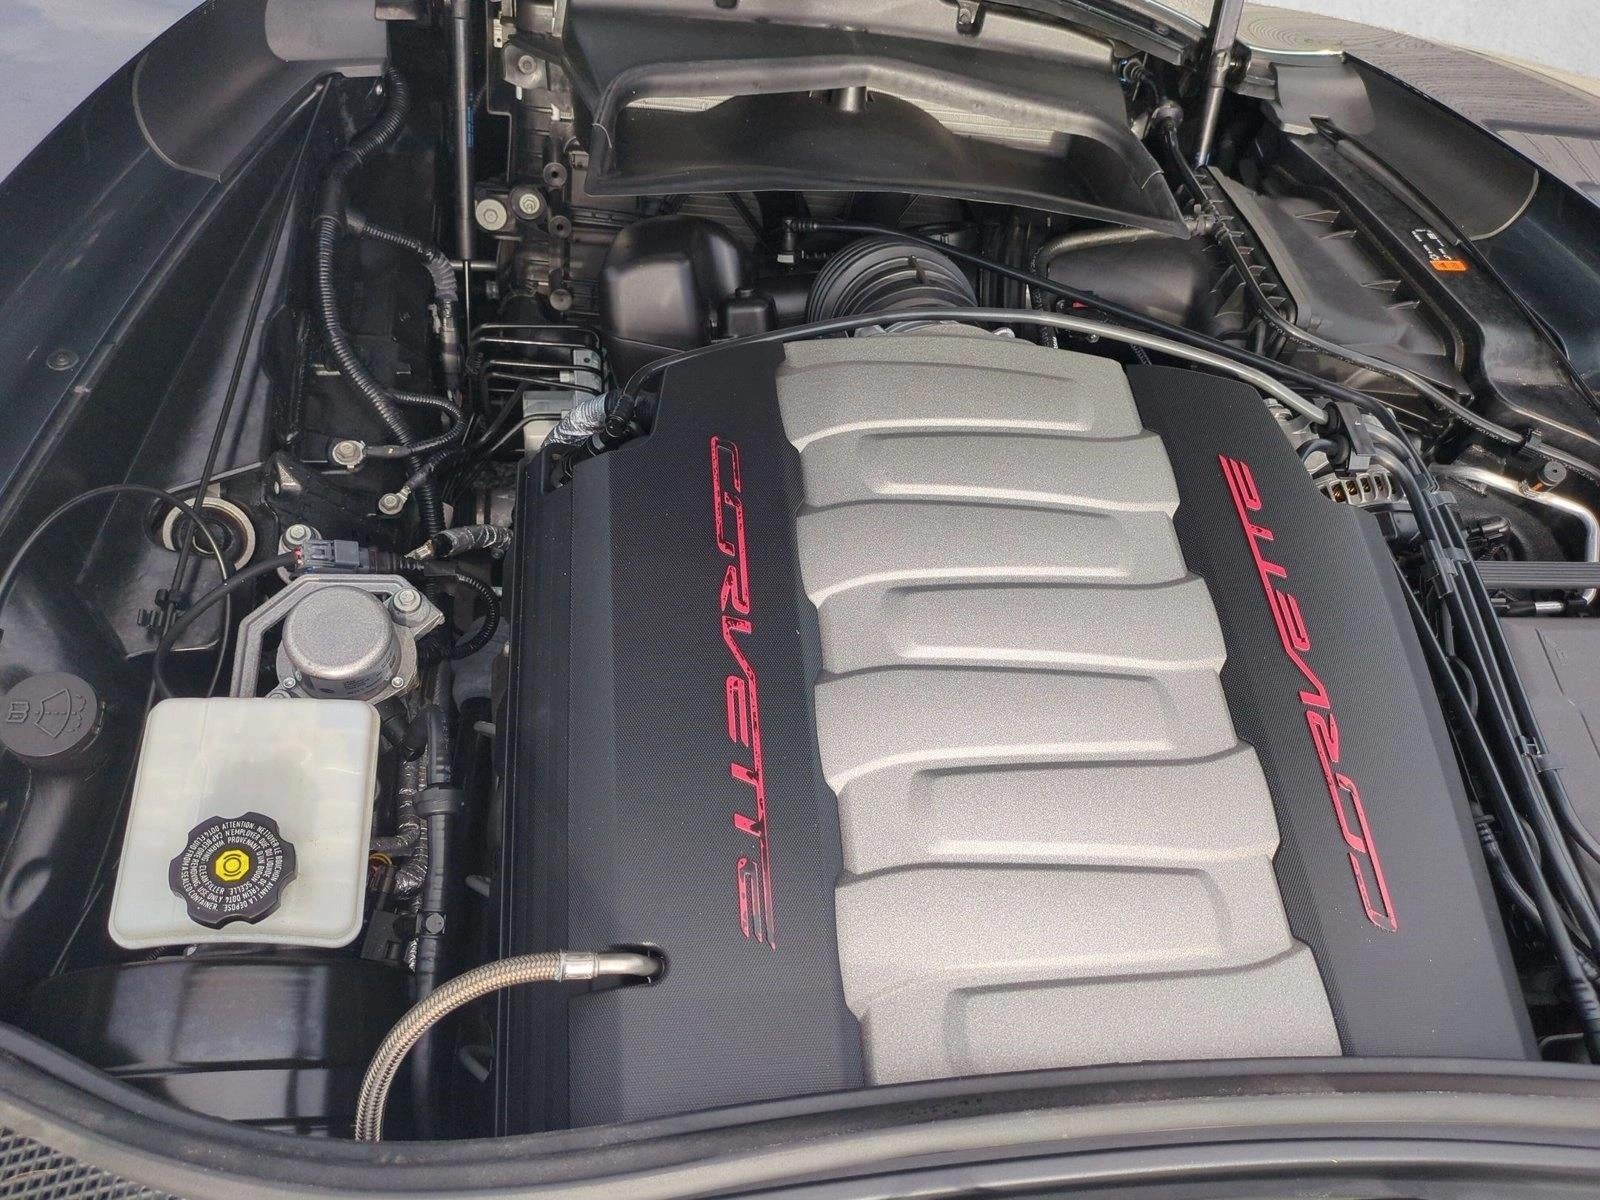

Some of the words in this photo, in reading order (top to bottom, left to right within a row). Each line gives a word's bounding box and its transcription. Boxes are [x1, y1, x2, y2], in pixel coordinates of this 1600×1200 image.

[710, 435, 776, 951] CORVETTE
[1218, 453, 1398, 933] CORVETTE
[203, 825, 220, 837] DOT4
[212, 832, 223, 842] CAP
[257, 826, 279, 847] NETTOYER
[190, 835, 206, 850] FLUID
[193, 839, 212, 859] BEFORE
[259, 838, 270, 849] QUE
[182, 849, 194, 866] FROM
[265, 848, 273, 857] DU
[274, 847, 282, 855] LE
[227, 837, 260, 851] PROVENANT
[251, 866, 264, 882] BIDON
[263, 857, 274, 878] LIQUIDE
[271, 855, 283, 881] BOUCHON
[181, 871, 193, 891] SEALED
[199, 865, 209, 883] CLEAN
[204, 880, 225, 894] FILLER
[257, 878, 266, 886] DE
[197, 886, 209, 897] USE
[207, 893, 223, 903] ONLY
[242, 885, 260, 899] FREIN
[258, 882, 273, 899] AVANT
[225, 895, 241, 903] DOT4
[248, 896, 258, 904] LA
